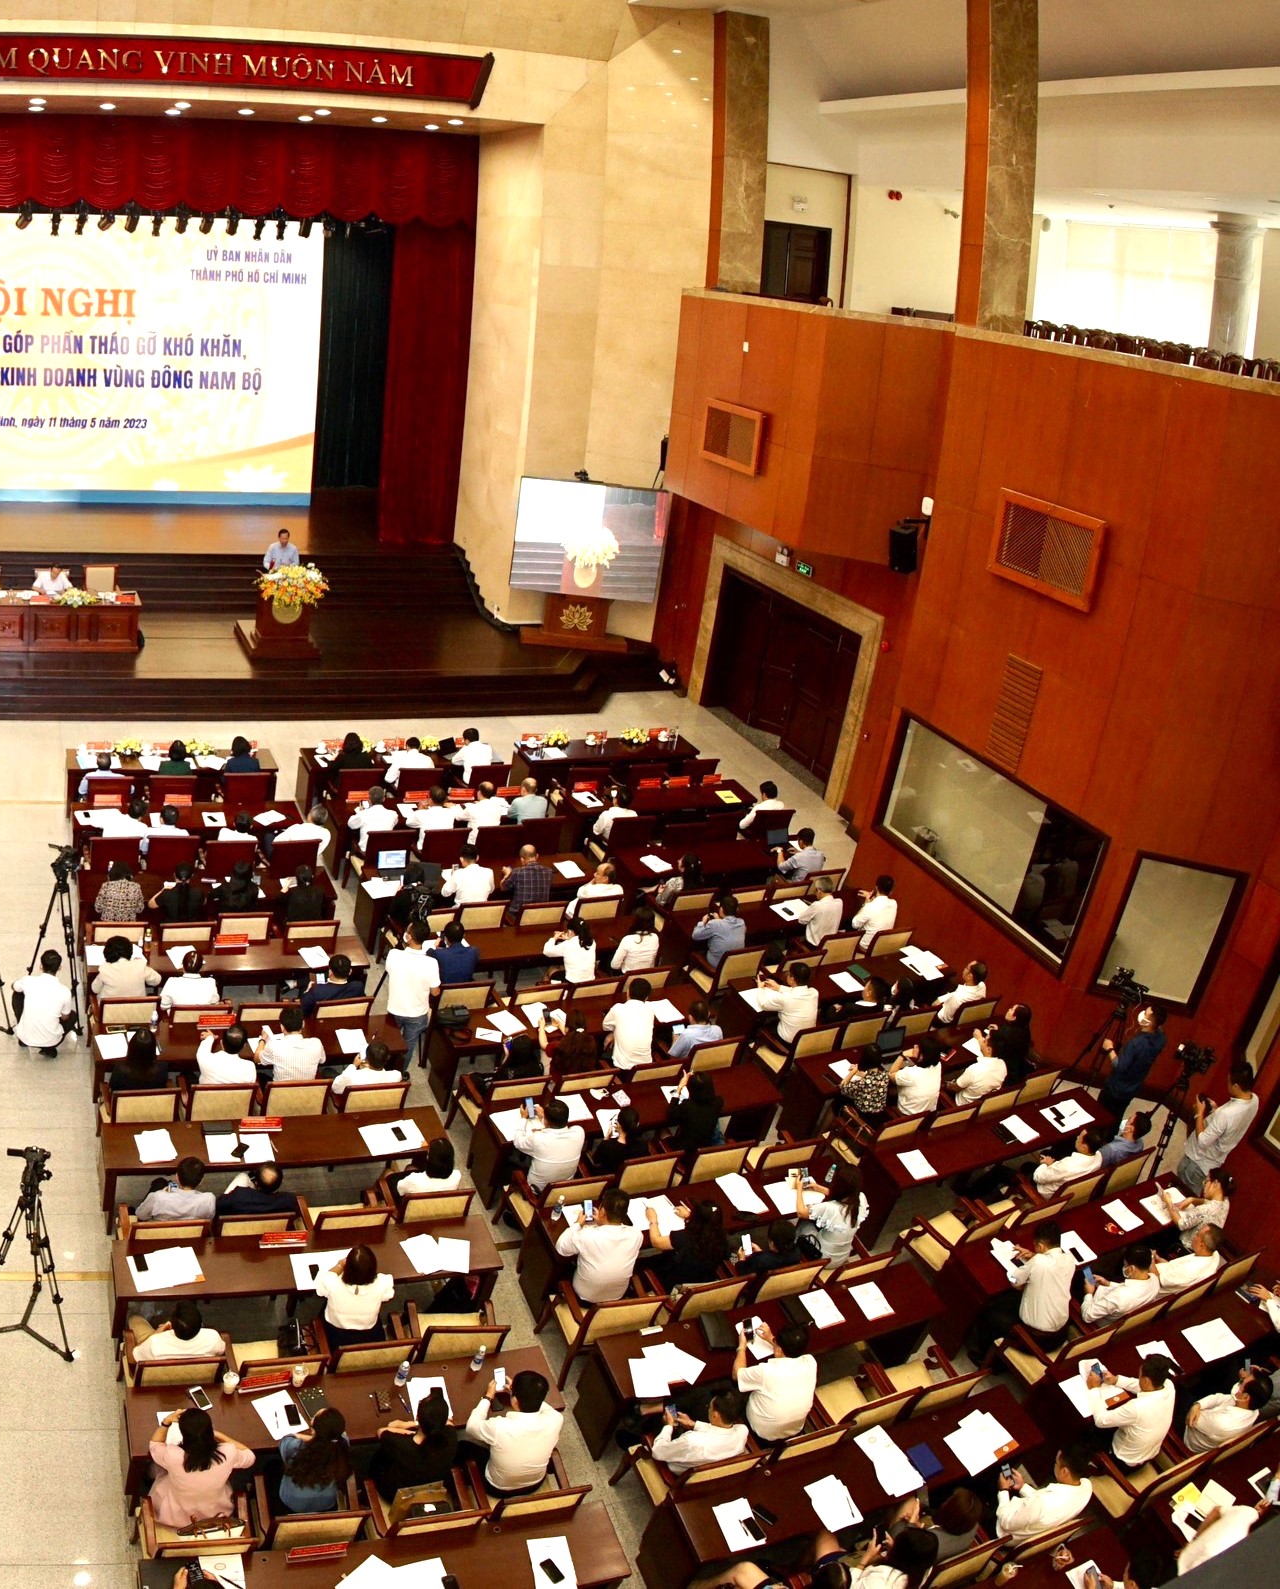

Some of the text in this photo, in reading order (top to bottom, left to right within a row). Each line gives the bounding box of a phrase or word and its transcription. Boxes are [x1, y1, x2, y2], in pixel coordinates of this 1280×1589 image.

[28, 47, 144, 75] QUANG
[153, 50, 234, 76] VINH
[242, 53, 336, 81] MUÔN
[344, 59, 414, 87] NĂM
[222, 249, 241, 262] BAN
[244, 248, 270, 264] NHÂN
[273, 248, 293, 264] DÂN
[190, 266, 222, 282] THÀNH
[263, 269, 279, 284] CHÍ
[281, 272, 307, 285] MINH
[40, 287, 137, 325] NGHỊ
[2, 329, 35, 354] GÓP
[40, 330, 84, 355] PHẦN
[89, 331, 130, 355] THÁO
[162, 333, 194, 357] KHÓ
[200, 333, 247, 360] KHĂN,
[0, 366, 37, 387] KINH
[43, 367, 98, 388] DOANH
[103, 364, 145, 388] VÙNG
[150, 364, 194, 389] ĐÔNG
[199, 370, 237, 390] NAM
[241, 367, 262, 396] BỘ
[21, 416, 46, 429] ngày
[48, 416, 57, 428] 11
[59, 416, 88, 429] tháng
[89, 417, 97, 429] 5
[98, 416, 121, 429] năm
[123, 418, 148, 429] 2023
